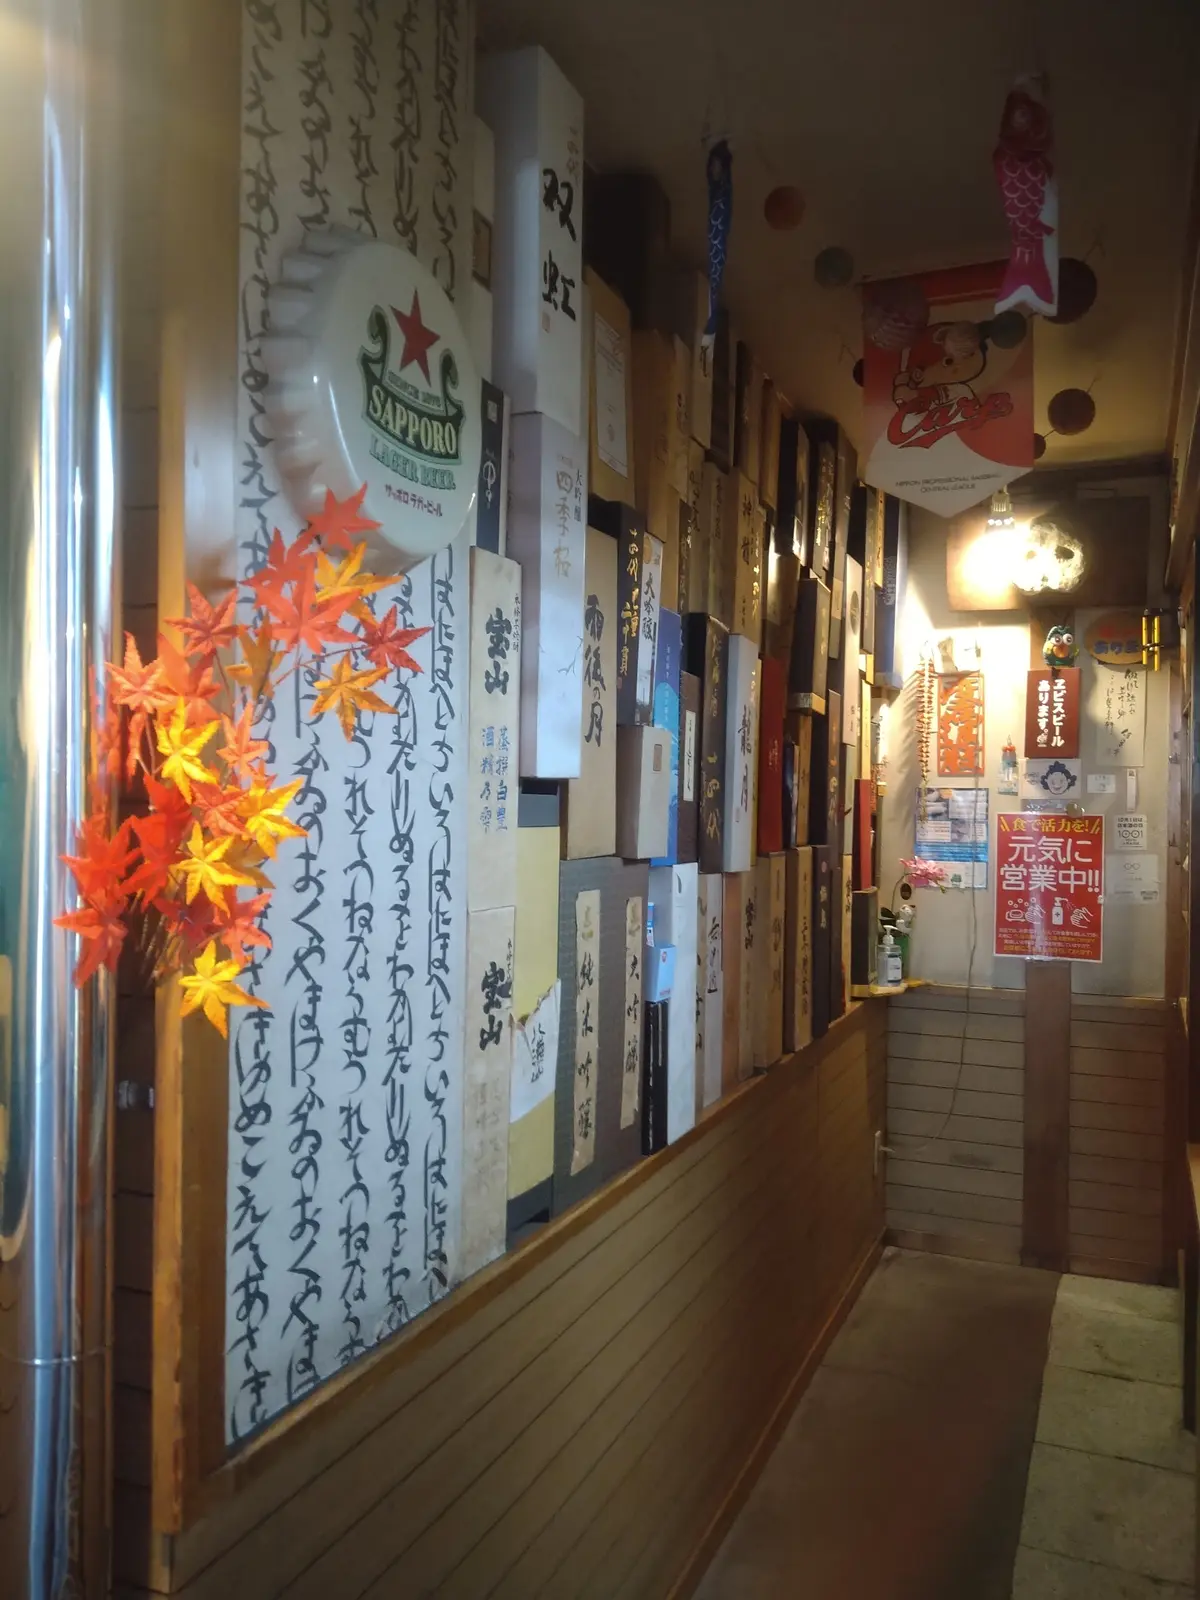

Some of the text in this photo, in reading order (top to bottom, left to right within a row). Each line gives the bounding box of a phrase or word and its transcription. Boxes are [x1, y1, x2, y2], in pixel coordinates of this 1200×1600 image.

[541, 167, 577, 322] 双虹
[368, 384, 457, 456] SAPPORO
[369, 436, 457, 490] LAGER BEER
[485, 607, 513, 696] 宝山
[584, 593, 607, 747] 雨後の月
[1008, 836, 1093, 864] 元気に
[480, 961, 506, 1051] 宝山
